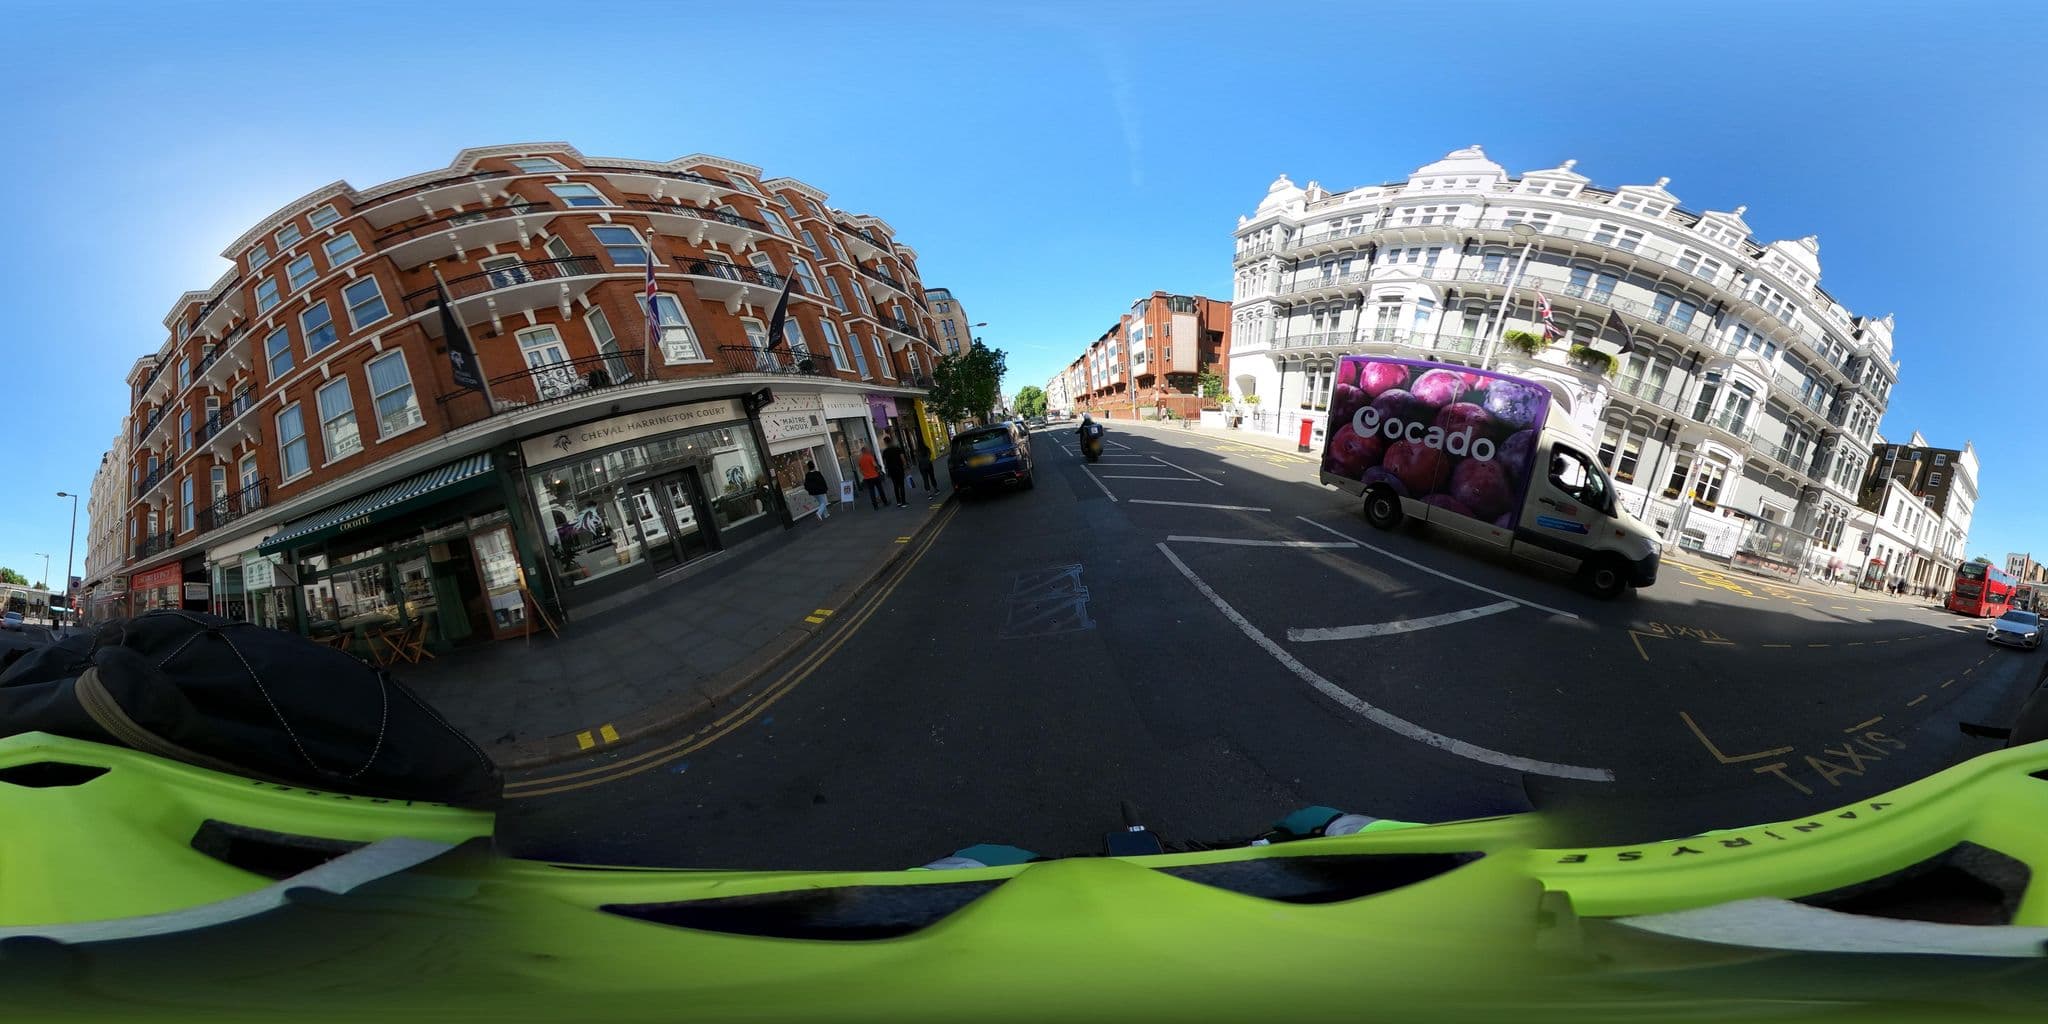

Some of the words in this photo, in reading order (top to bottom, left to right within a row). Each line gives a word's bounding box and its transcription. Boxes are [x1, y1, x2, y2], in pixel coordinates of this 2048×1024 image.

[581, 426, 624, 442] CHEVAL
[627, 411, 694, 432] HARRINGTON
[696, 407, 726, 418] COURT
[784, 423, 809, 432] CHOUX
[1384, 417, 1496, 462] ocado
[339, 517, 371, 532] COCOTTE
[1753, 730, 1907, 796] TAXIS
